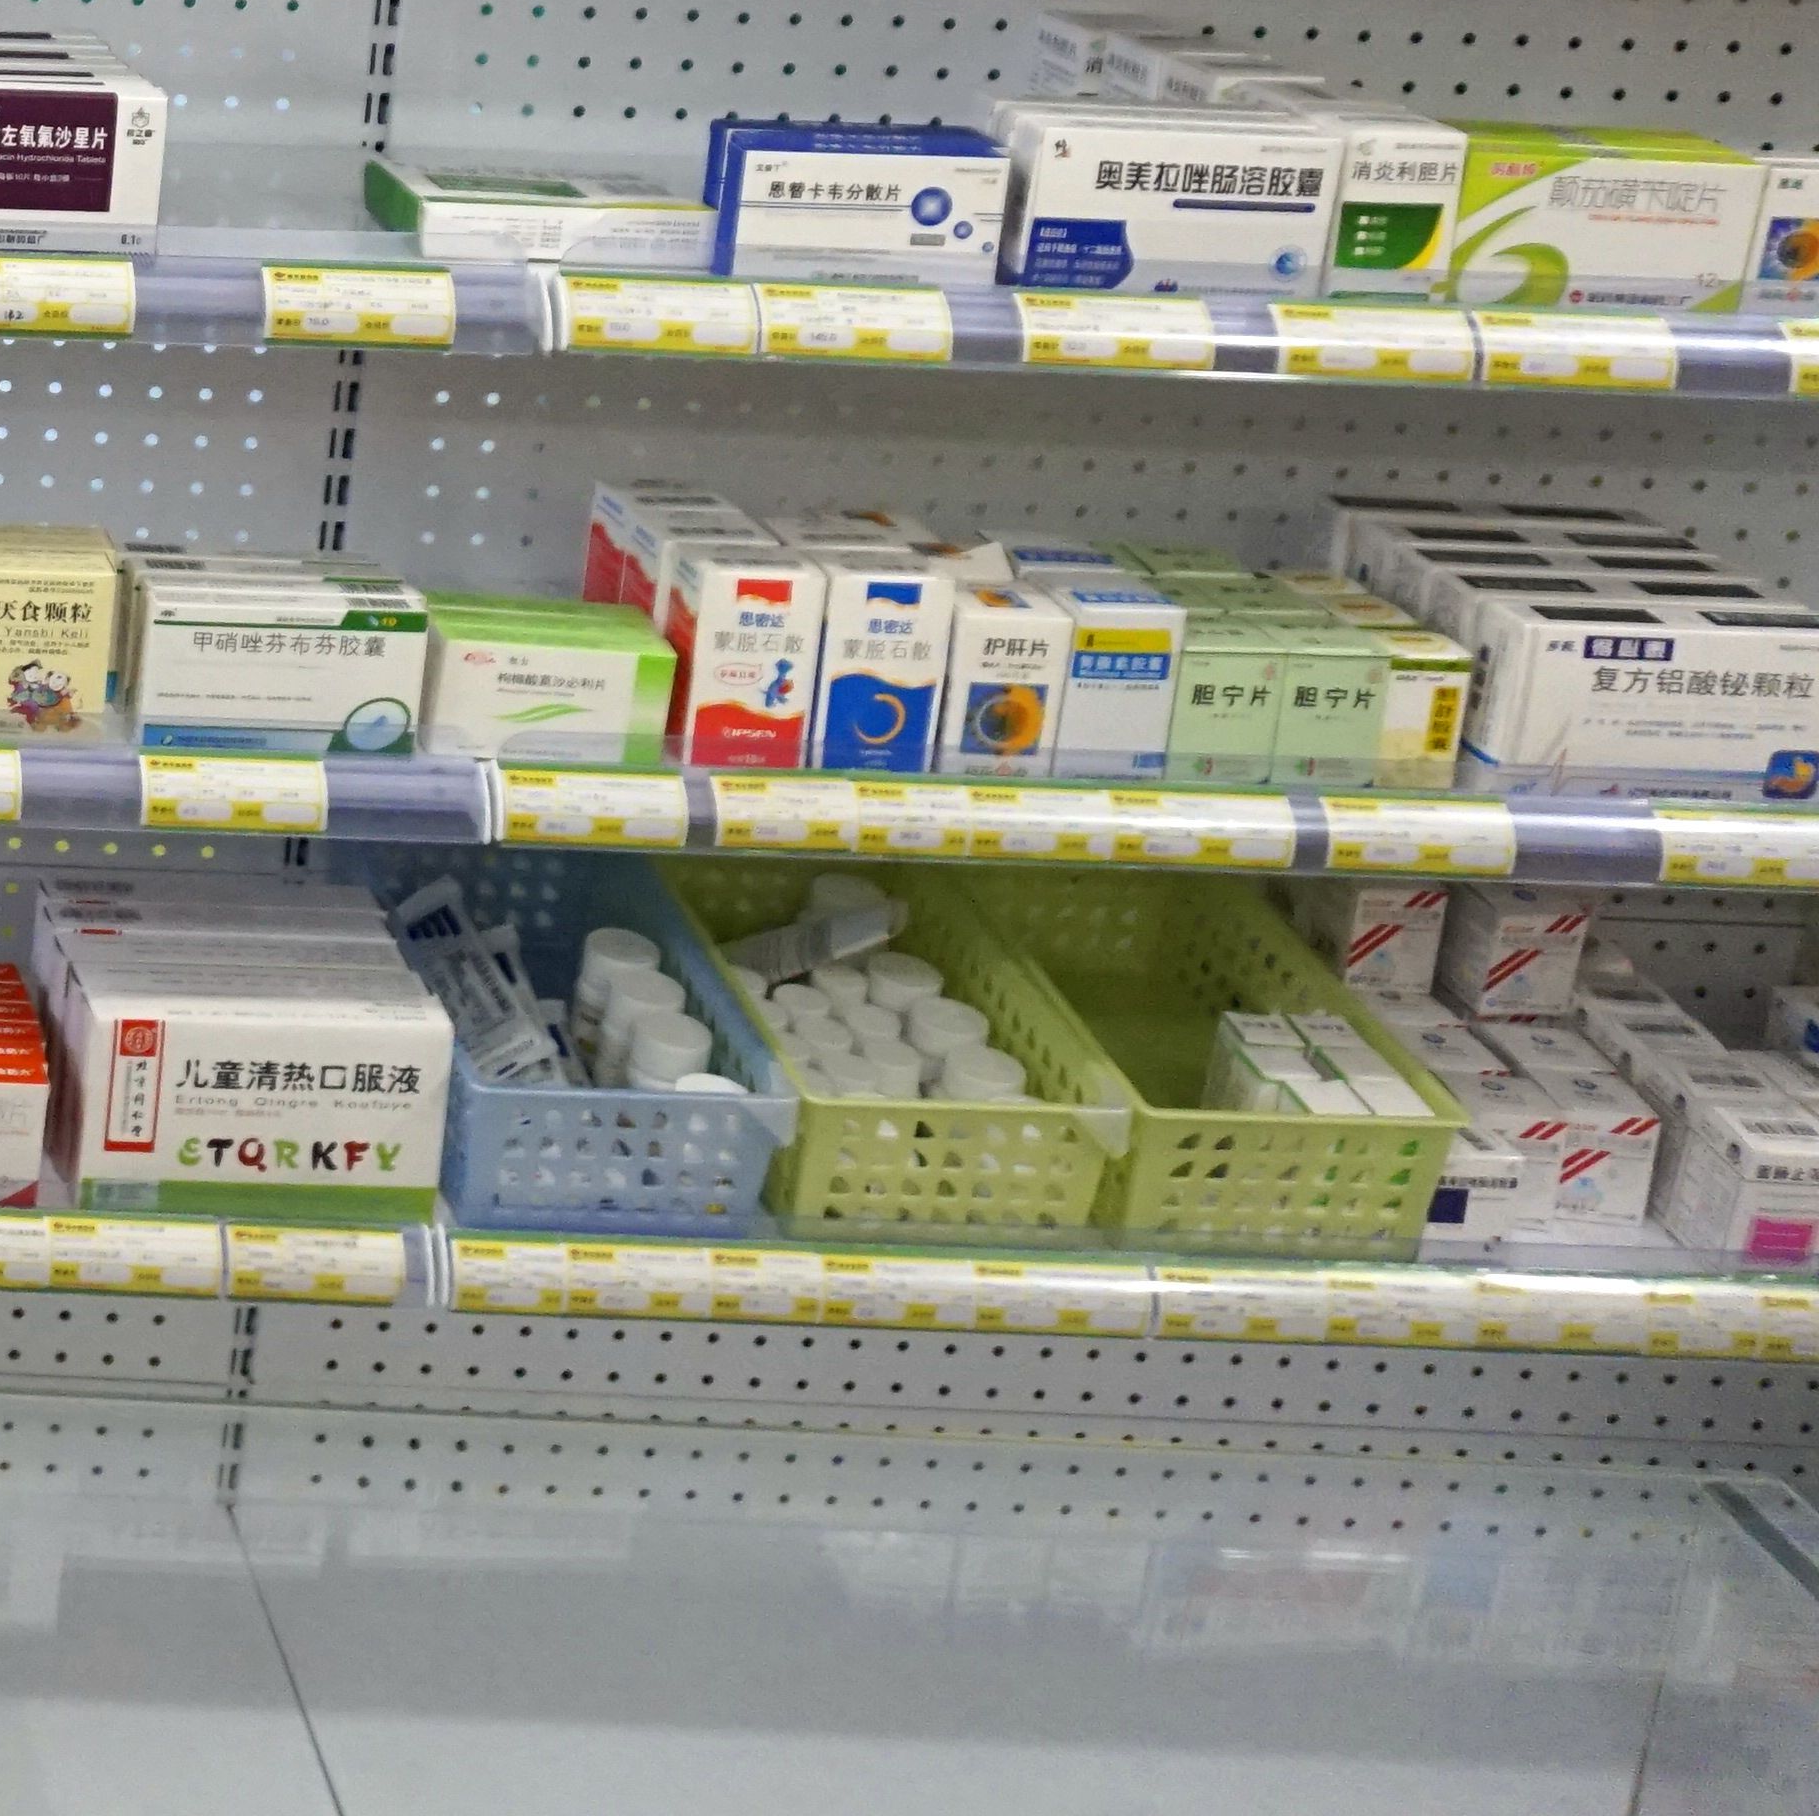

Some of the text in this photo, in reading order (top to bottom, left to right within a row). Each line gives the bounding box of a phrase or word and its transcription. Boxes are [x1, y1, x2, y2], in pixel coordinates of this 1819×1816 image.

[1095, 159, 1324, 197] 奥美拉唑肠溶胶囊
[1351, 158, 1459, 184] 消炎利胆片
[768, 180, 902, 202] 恩替卡韦分散片
[738, 611, 786, 628] 思密达
[868, 616, 916, 634] 思密达
[193, 631, 387, 658] 甲硝唑芬布芬胶囊
[714, 630, 805, 654] 蒙脱石散
[842, 638, 932, 661] 蒙脱石散
[984, 637, 1050, 658] 护肝片
[1591, 665, 1815, 699] 复方铝酸铋颗粒
[1191, 683, 1272, 708] 胆宁片
[1293, 684, 1376, 710] 胆宁片
[175, 1059, 423, 1096] 儿童清热口服液
